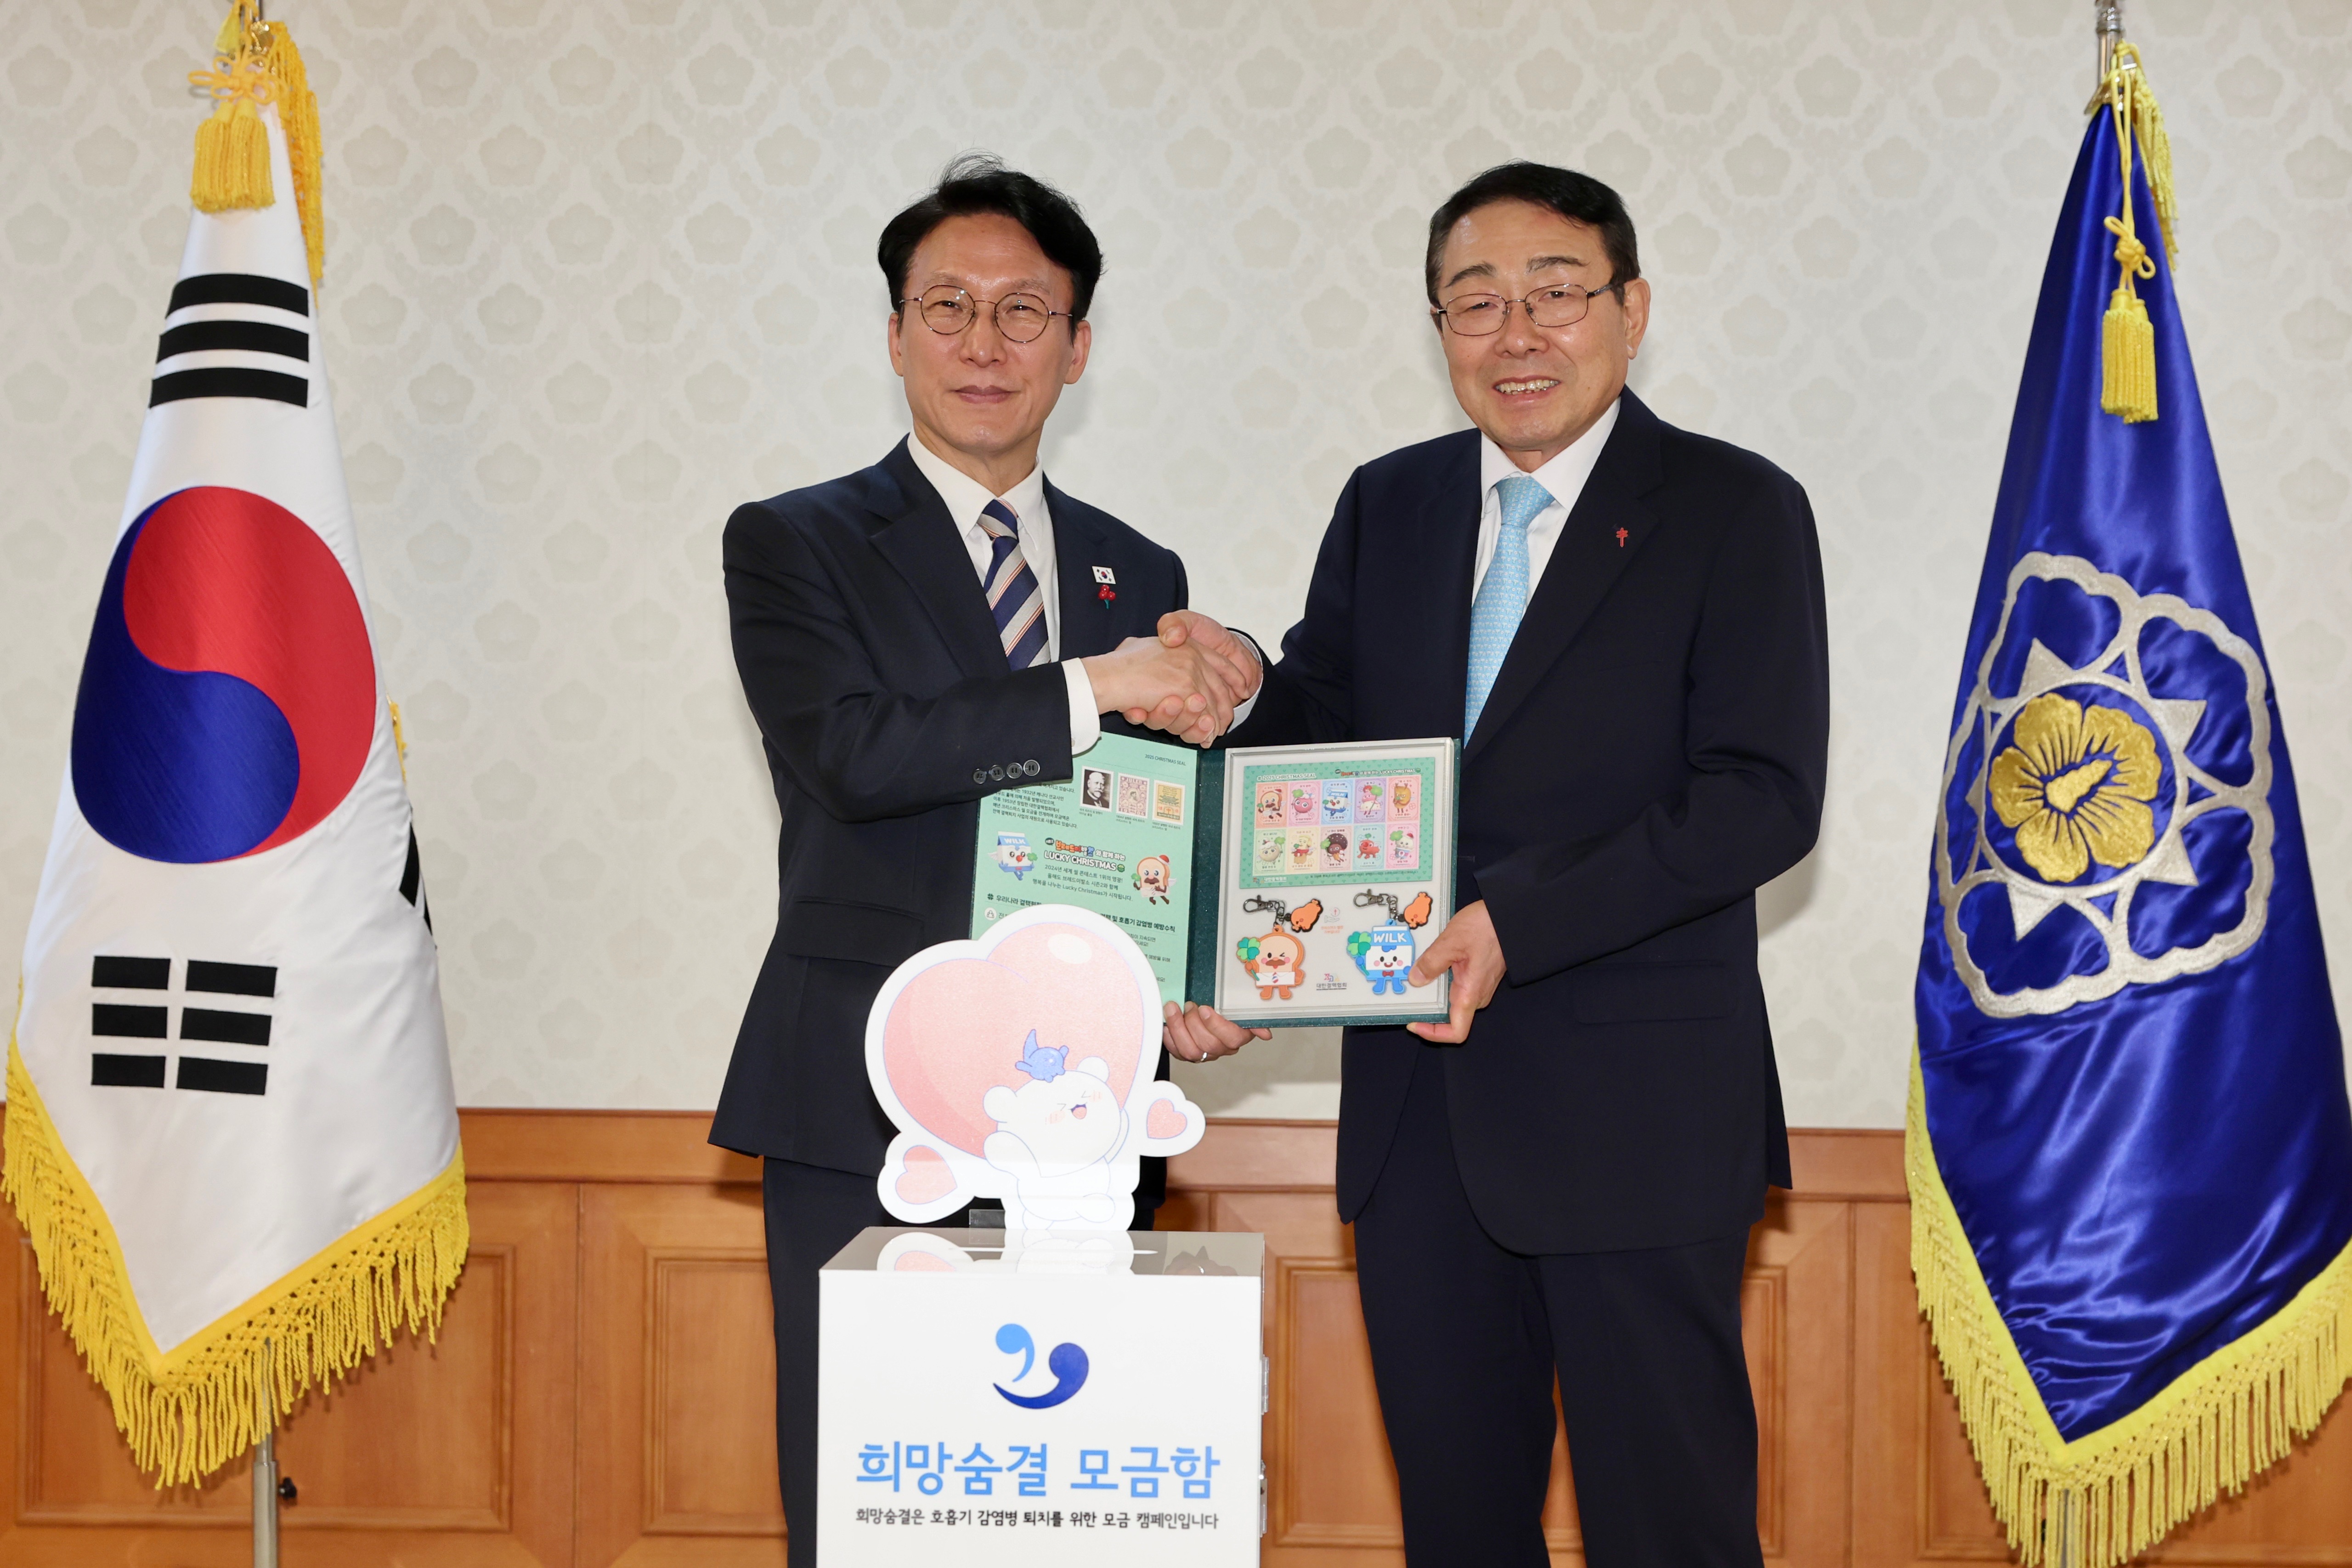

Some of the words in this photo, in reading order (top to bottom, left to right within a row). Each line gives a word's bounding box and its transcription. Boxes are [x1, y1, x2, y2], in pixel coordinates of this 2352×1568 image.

[1154, 756, 1176, 764] CHRISTMAS
[1044, 850, 1070, 863] LUCKY
[1071, 855, 1117, 871] CHRISTMAS
[1045, 864, 1062, 872] 2024년
[1079, 870, 1098, 878] 콘테스트
[1063, 876, 1090, 885] 브레드이발소
[996, 895, 1019, 905] 우리나라
[1078, 887, 1108, 897] Christmas가
[1108, 892, 1133, 901] 시작됩니다.
[1119, 917, 1135, 925] 호흡기
[1136, 920, 1153, 928] 감염병
[1153, 923, 1175, 932] 예방수칙
[1374, 933, 1407, 943] WILK
[857, 1441, 1047, 1496] 희망숨결
[1070, 1446, 1220, 1498] 모금함
[856, 1508, 925, 1525] 희망숨결은
[930, 1509, 971, 1525] 호흡기
[977, 1510, 1018, 1526] 감염병
[1023, 1511, 1064, 1527] 퇴치를
[1069, 1511, 1097, 1528] 위한
[1102, 1512, 1131, 1528] 모금
[1136, 1512, 1218, 1529] 캠페인입니다
